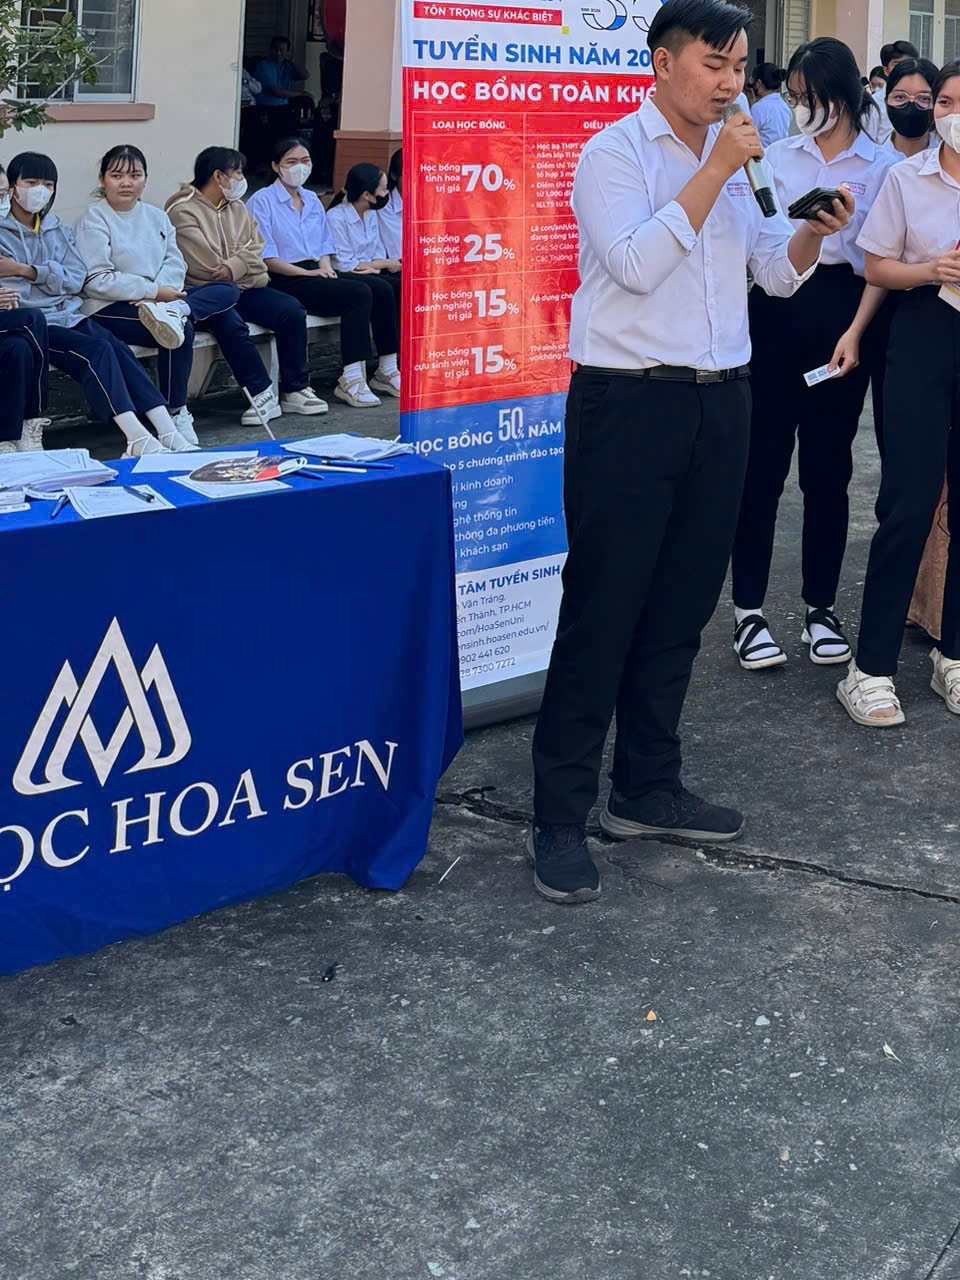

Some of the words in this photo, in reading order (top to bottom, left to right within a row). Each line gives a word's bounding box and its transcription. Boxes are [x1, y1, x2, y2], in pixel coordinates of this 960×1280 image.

[423, 4, 448, 17] TÔN
[449, 7, 486, 20] TRỌNG
[487, 8, 501, 21] SỰ
[503, 8, 530, 21] KHÁC
[532, 10, 553, 23] BIỆT
[413, 34, 498, 62] TUYỂN
[504, 42, 562, 65] SINH
[569, 41, 620, 67] NĂM
[627, 48, 651, 67] 20
[412, 80, 466, 105] HỌC
[474, 75, 542, 102] BỔNG
[549, 82, 612, 103] TOÀN
[432, 120, 456, 131] LOẠI
[457, 120, 477, 132] HỌC
[420, 163, 437, 172] Học
[425, 174, 443, 182] tinh
[444, 174, 461, 182] hoa
[461, 164, 516, 192] 70%
[419, 235, 437, 244] Học
[463, 233, 515, 262] 25%
[423, 246, 442, 256] giáo
[443, 245, 460, 255] dục
[432, 292, 449, 302] Học
[474, 288, 520, 318] 15%
[414, 303, 442, 313] doanh
[428, 350, 446, 359] Học
[471, 344, 517, 375] 15%
[431, 360, 450, 369] sinh
[528, 419, 561, 438] NĂM
[458, 460, 465, 470] 5
[466, 455, 503, 469] chương
[505, 448, 529, 462] trình
[530, 447, 548, 459] đào
[549, 445, 565, 458] tạo
[460, 480, 481, 492] kinh
[483, 474, 514, 488] doanh
[453, 514, 473, 528] ghệ
[473, 509, 503, 522] thông
[504, 506, 518, 517] tin
[486, 526, 498, 537] đa
[500, 520, 536, 536] phương
[537, 515, 556, 528] tiện
[460, 544, 491, 558] khách
[491, 541, 509, 553] sạn
[458, 580, 487, 596] TÂM
[489, 568, 529, 590] TUYỂN
[532, 565, 561, 580] SINH
[461, 599, 479, 609] Văn
[459, 621, 549, 651] nsinh.hoasen.edu.vn/
[460, 653, 477, 665] 902
[478, 648, 493, 659] 441
[494, 644, 511, 656] 620
[0, 807, 91, 893] ỌC
[109, 766, 268, 856] HOA
[283, 739, 399, 810] SEN
